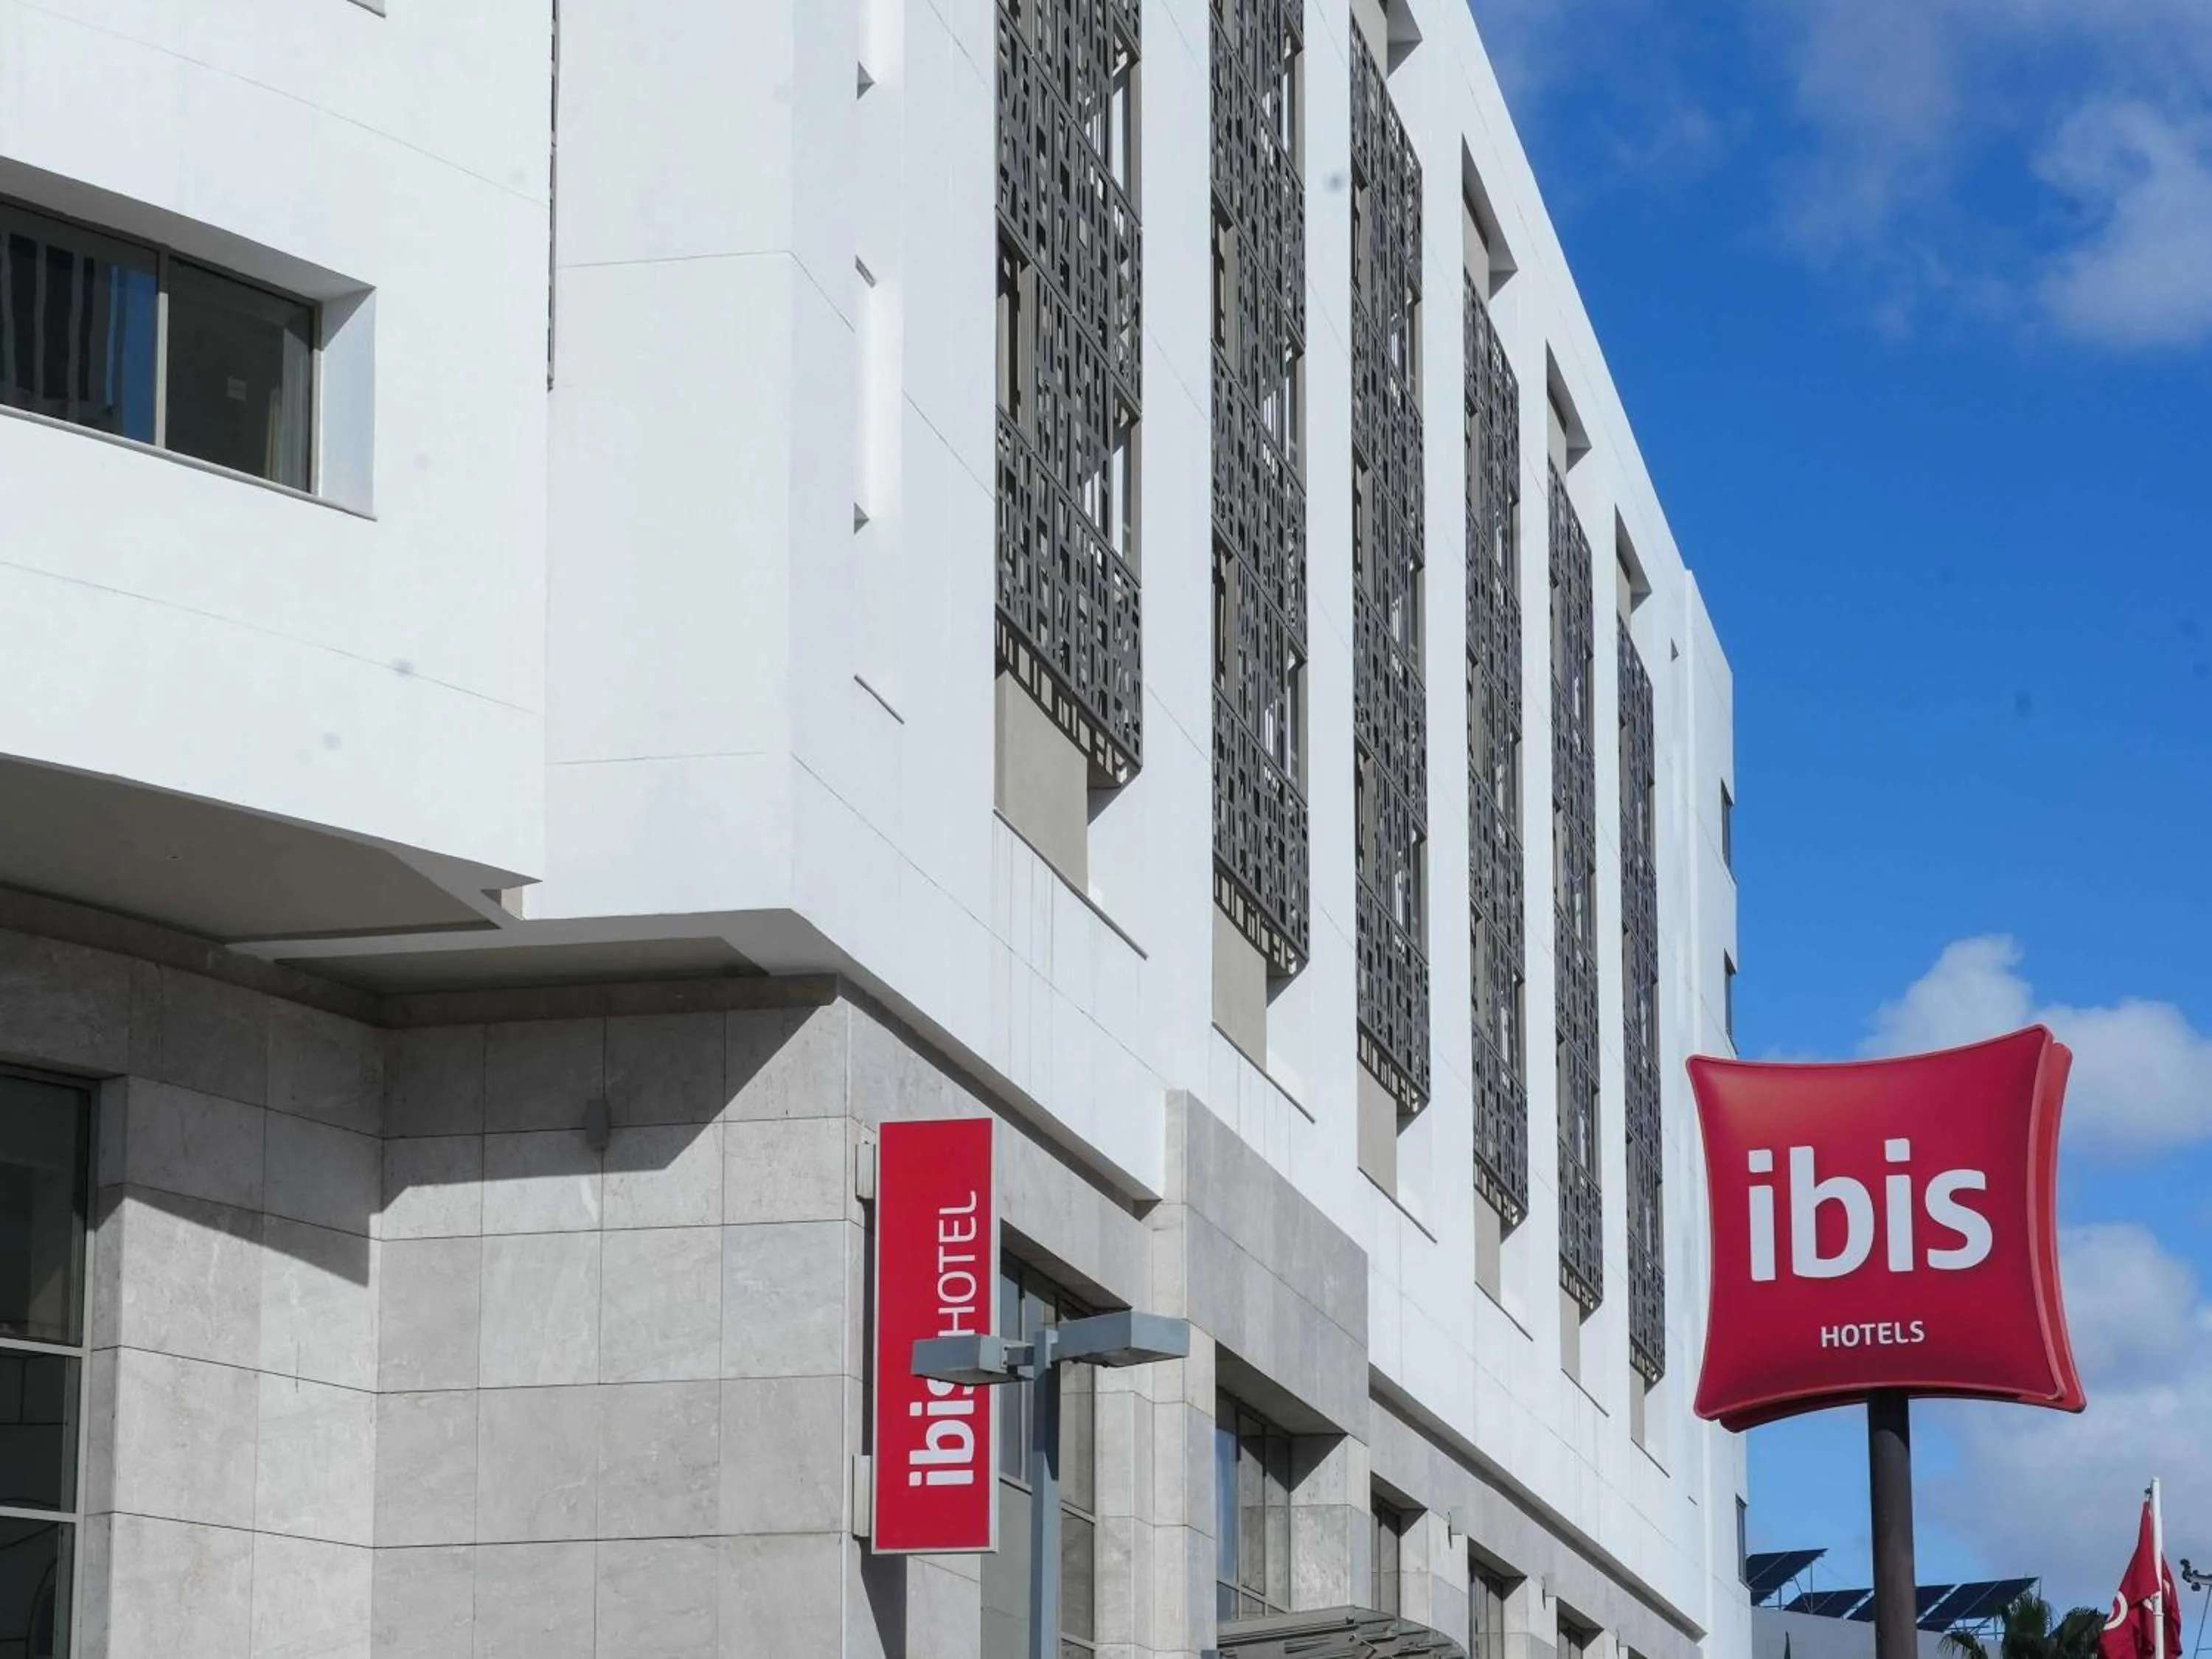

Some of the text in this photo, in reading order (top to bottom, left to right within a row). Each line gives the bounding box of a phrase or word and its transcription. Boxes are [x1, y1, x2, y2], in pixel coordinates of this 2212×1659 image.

[937, 1190, 977, 1337] HOTEL
[1748, 1138, 1993, 1281] ibis
[1820, 1321, 1925, 1348] HOTELS
